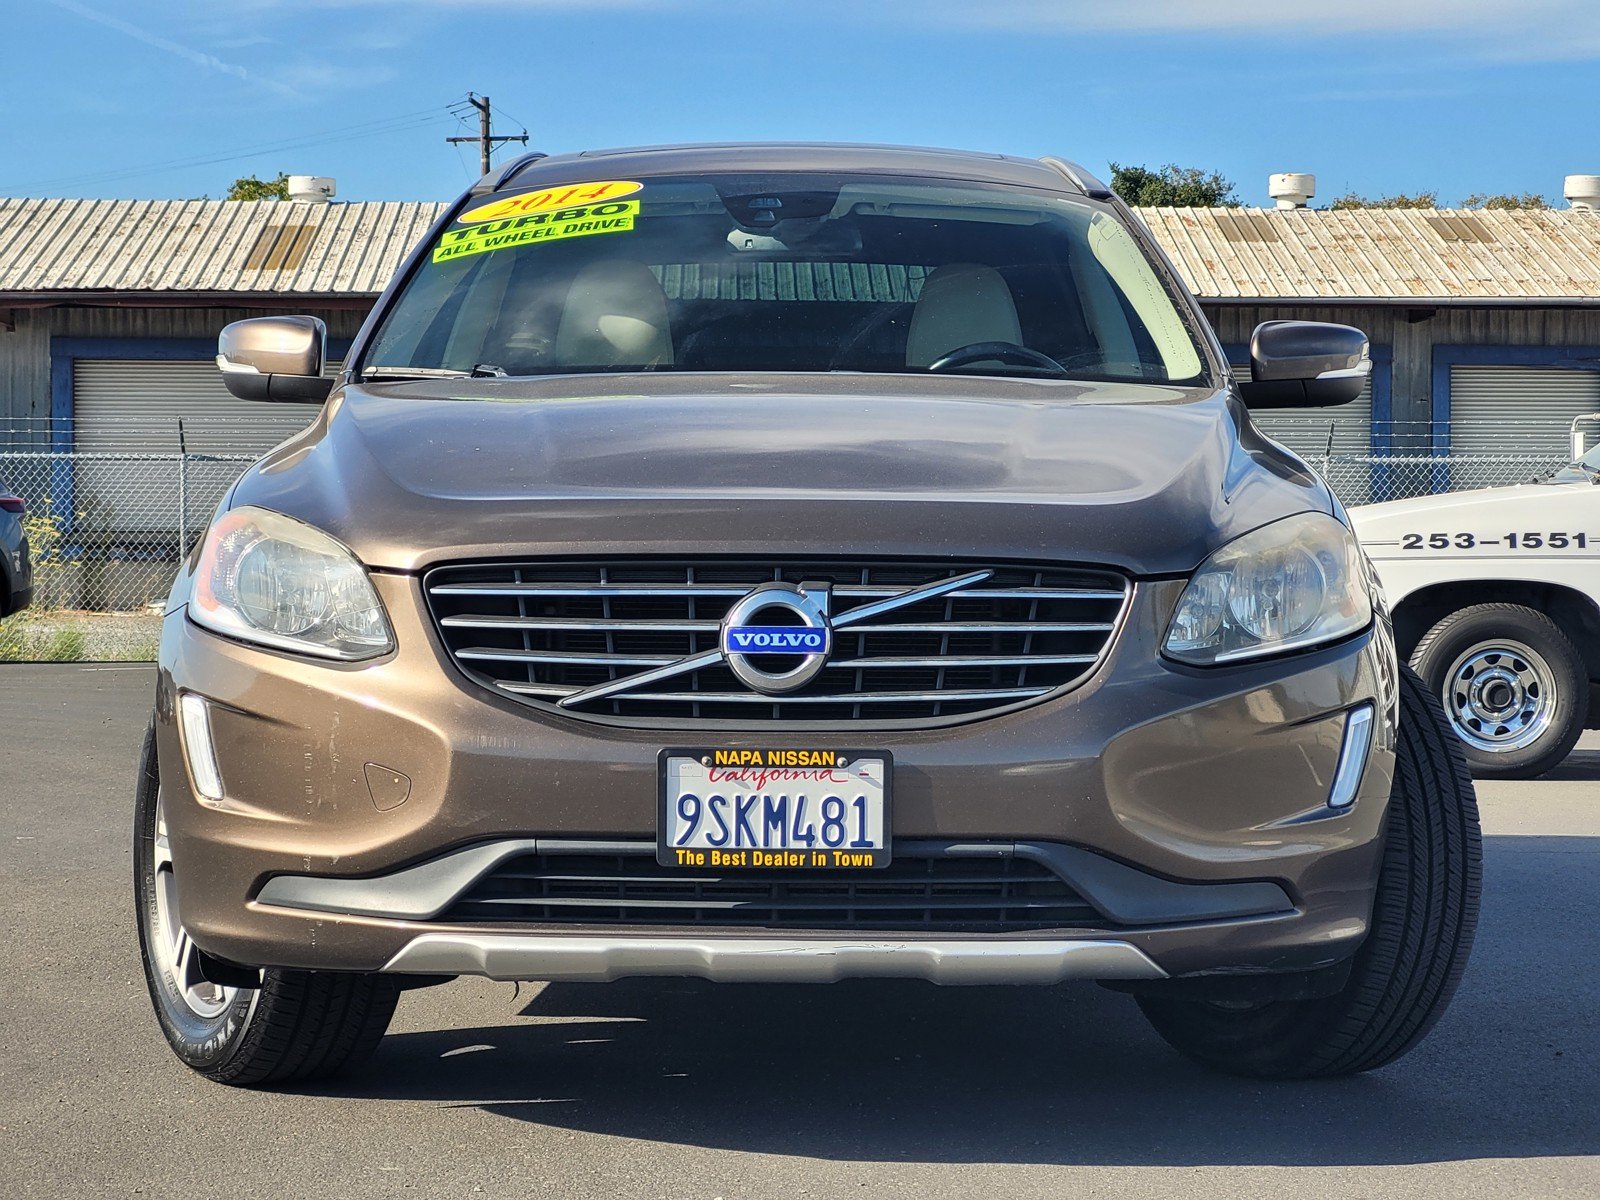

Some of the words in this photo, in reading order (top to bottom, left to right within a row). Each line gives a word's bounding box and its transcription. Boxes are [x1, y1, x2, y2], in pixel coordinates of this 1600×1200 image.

[490, 183, 614, 218] 2014
[450, 203, 632, 241] TURBO
[436, 242, 477, 259] ALL
[484, 227, 556, 247] WHEEL
[562, 217, 629, 234] DRIVE
[1402, 532, 1586, 550] 253-1551
[733, 633, 821, 647] VOLVO
[715, 750, 763, 766] NAPA
[768, 751, 835, 767] NISSAN
[708, 767, 848, 791] California
[676, 793, 874, 848] 9SKM481
[676, 849, 705, 866] The
[711, 850, 747, 866] Best
[753, 851, 806, 867] Dealer
[812, 851, 827, 866] in
[833, 851, 873, 867] Town
